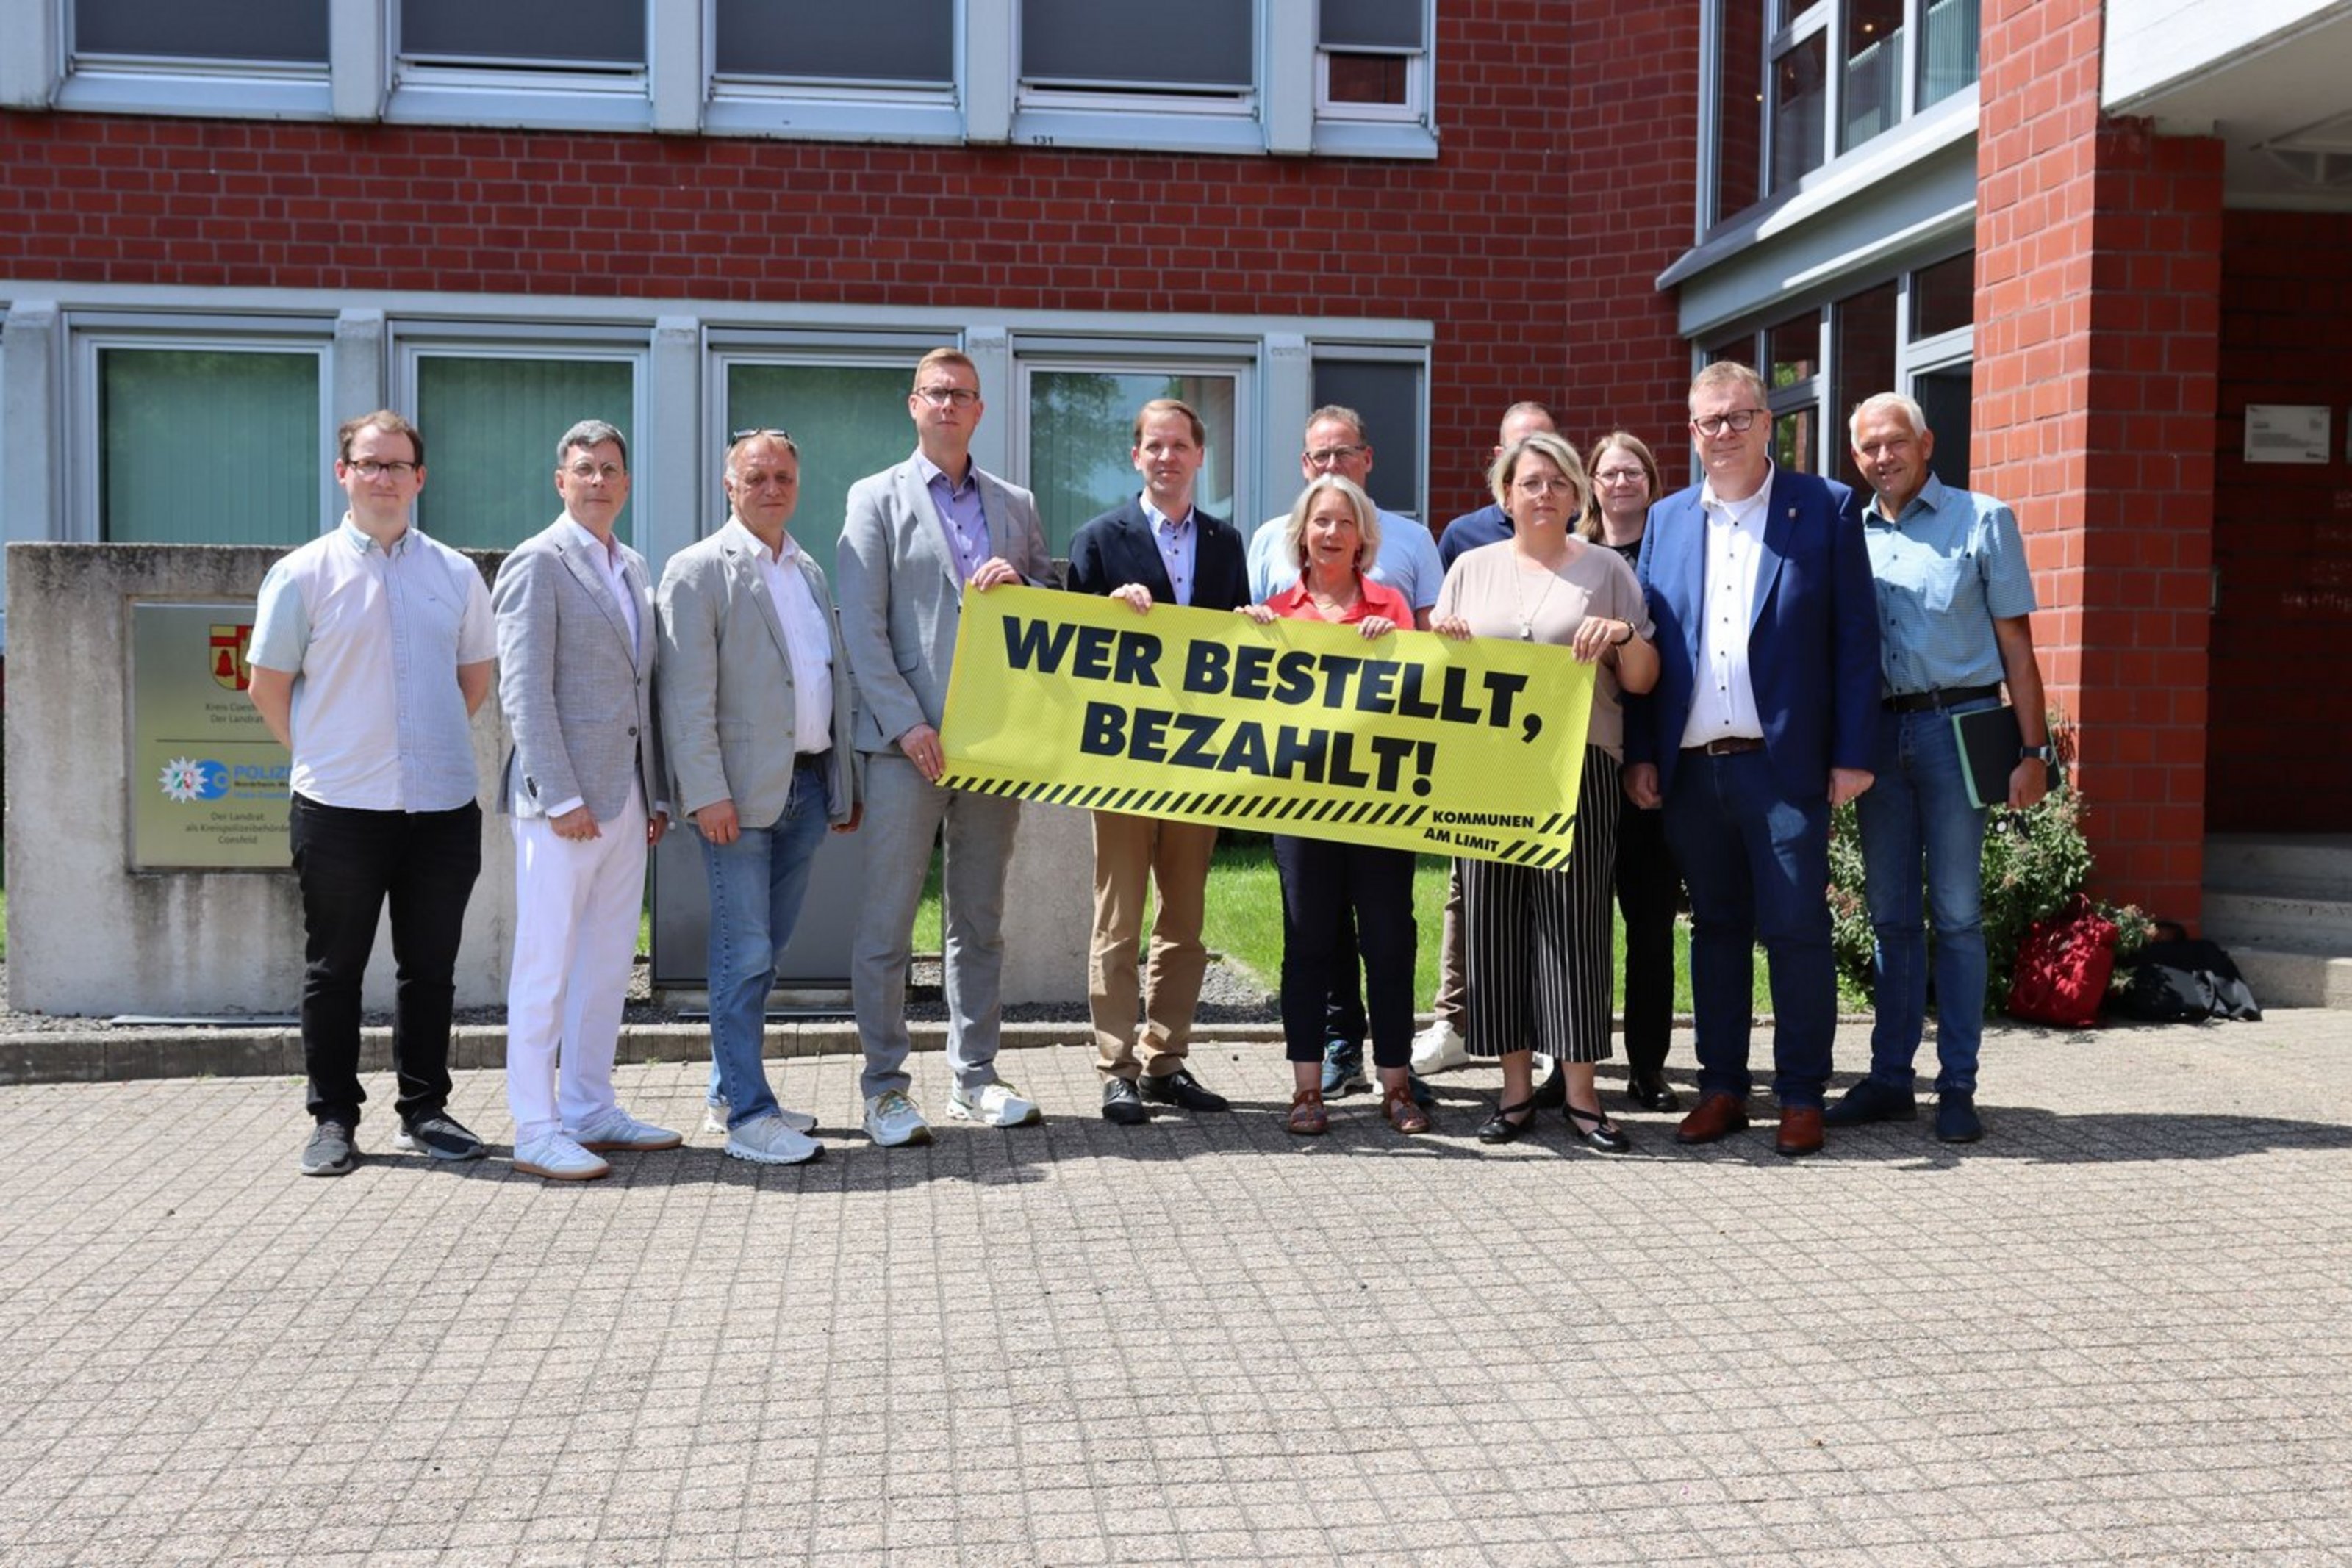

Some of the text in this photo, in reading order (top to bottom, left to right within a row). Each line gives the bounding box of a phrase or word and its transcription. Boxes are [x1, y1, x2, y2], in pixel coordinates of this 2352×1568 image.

[1002, 615, 1543, 744] WER BESTELLT,
[210, 714, 263, 722] Der Landrat
[1080, 701, 1437, 797] BEZAHLT!
[234, 766, 292, 780] POLIZ
[211, 812, 264, 821] Der Landrat
[1433, 810, 1534, 828] KOMMUNEN
[218, 835, 257, 844] Coesfeld
[1424, 827, 1500, 852] AM LIMIT
